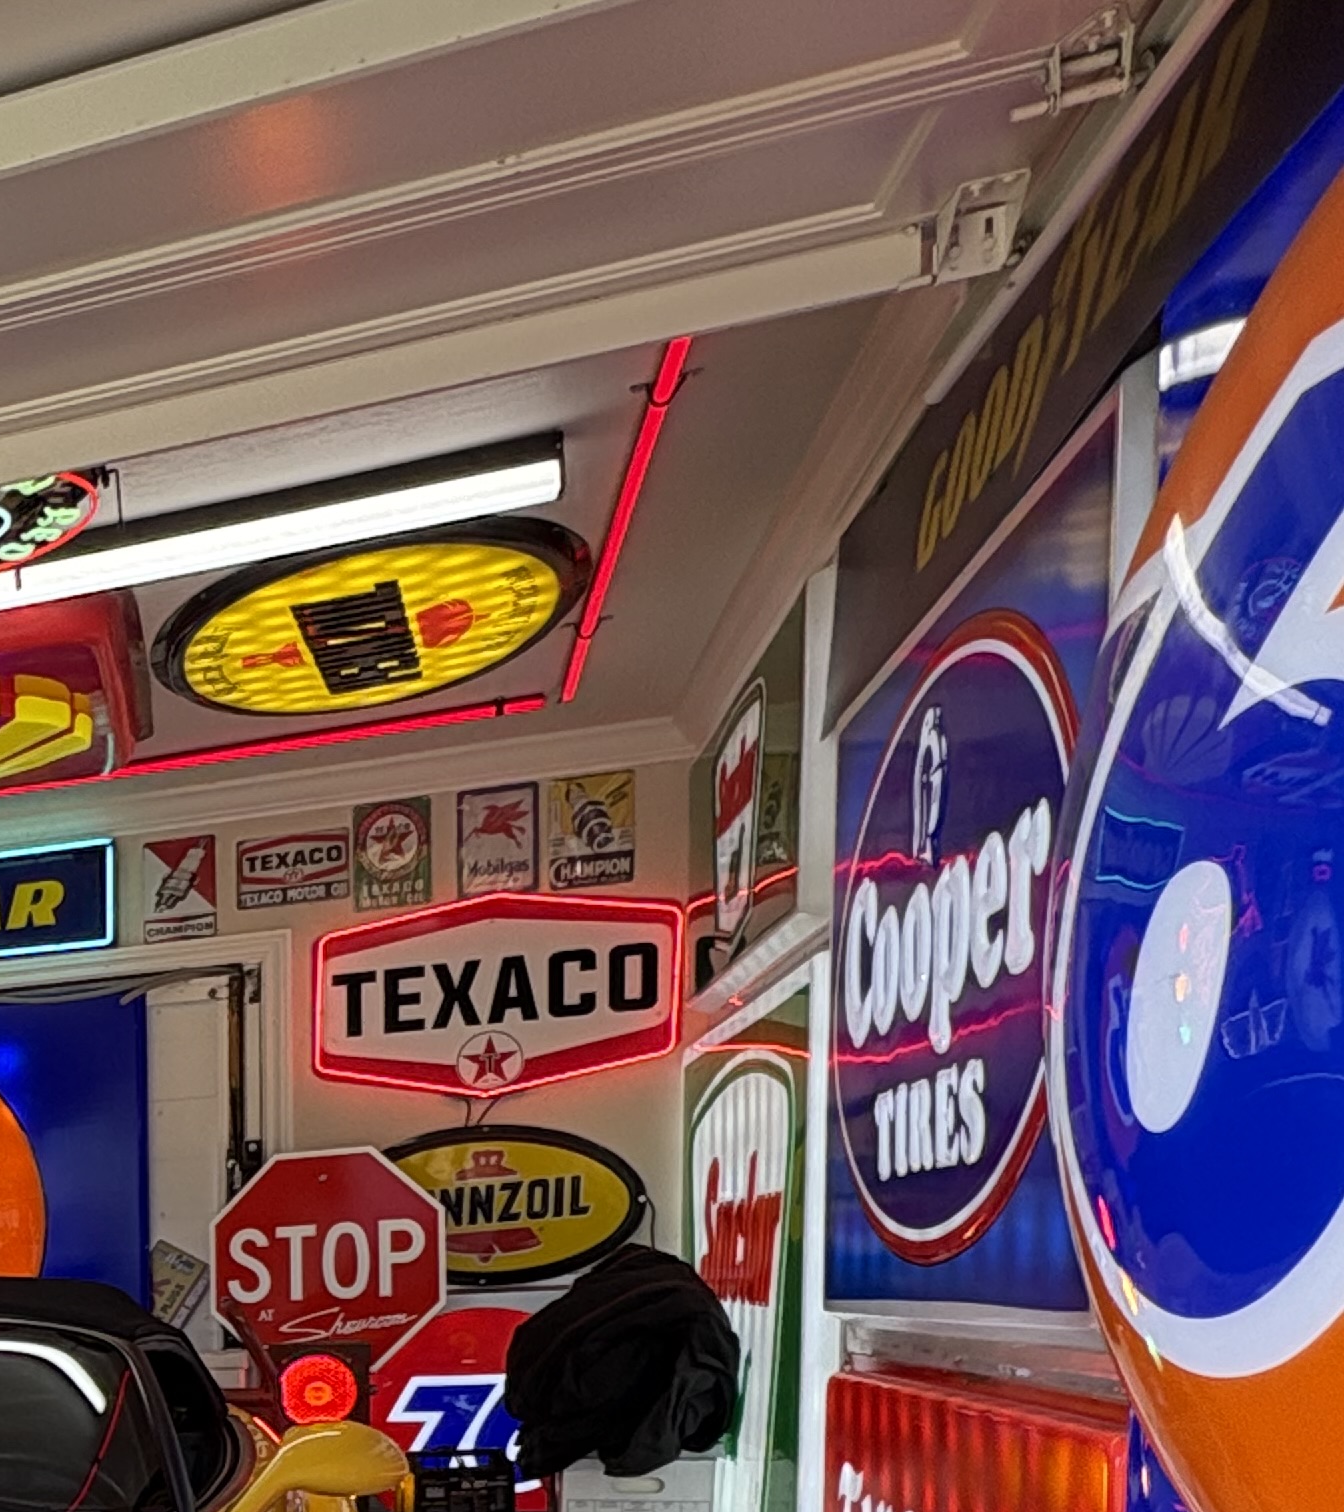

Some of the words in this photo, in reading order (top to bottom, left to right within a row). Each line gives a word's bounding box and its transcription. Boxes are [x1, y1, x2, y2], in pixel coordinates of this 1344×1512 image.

[245, 845, 343, 874] TEXACO
[466, 857, 530, 880] Mobilgas
[550, 856, 633, 888] CHAMPION
[240, 888, 283, 907] TEXACO
[286, 884, 327, 903] MOTOR
[146, 919, 214, 937] CHAMPION
[844, 797, 1050, 1054] Cooper
[331, 941, 660, 1040] TEXACO
[873, 1057, 986, 1182] TIRES
[426, 1174, 592, 1228] NNZOIL
[227, 1219, 426, 1304] STOP
